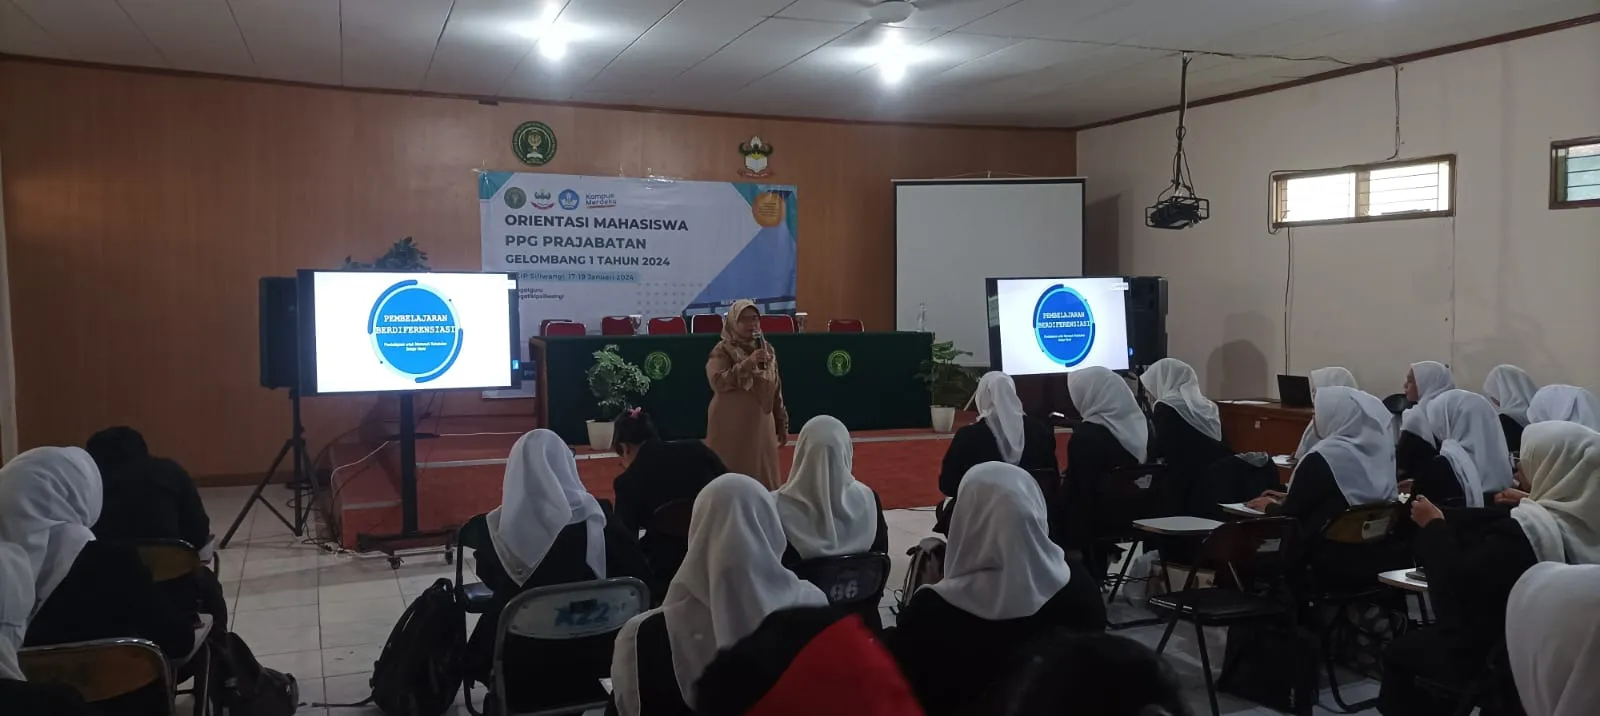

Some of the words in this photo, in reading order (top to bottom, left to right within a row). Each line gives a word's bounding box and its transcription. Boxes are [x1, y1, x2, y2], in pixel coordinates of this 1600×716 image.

[505, 214, 589, 228] ORIENTASI
[593, 217, 688, 231] MAHASISWA
[505, 235, 538, 247] PPG
[543, 235, 646, 249] PRAJABATAN
[505, 254, 586, 265] GELOMBANG
[588, 255, 594, 265] 1
[596, 255, 639, 265] TAHUN
[641, 256, 671, 266] 2024
[384, 314, 448, 322] PEMBELAJARAN
[1042, 311, 1085, 319] PEMBELAJARAN
[1038, 320, 1091, 328] BERDIFERENSIASI
[376, 325, 456, 334] BERDIFERENSIASI
